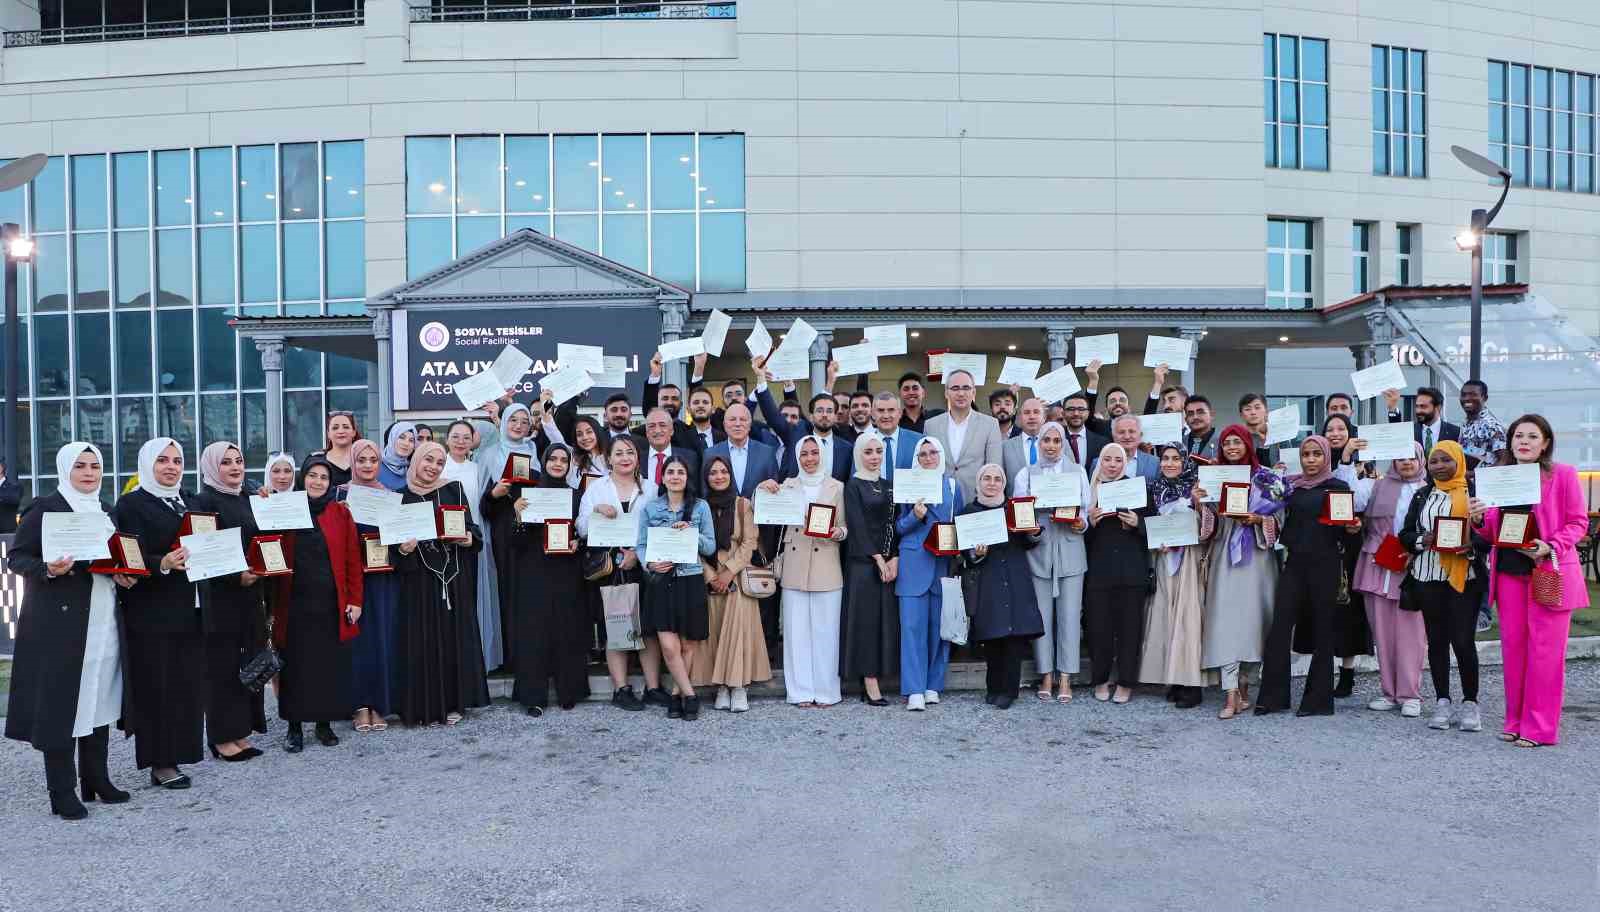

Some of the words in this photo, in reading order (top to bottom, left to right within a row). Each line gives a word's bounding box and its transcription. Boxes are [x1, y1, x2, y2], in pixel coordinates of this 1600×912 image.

[455, 327, 494, 336] SOSYAL
[496, 326, 543, 336] TESİSLER
[455, 337, 480, 346] Social
[483, 337, 519, 345] Facilities
[420, 361, 460, 376] ATA
[421, 380, 453, 395] Ata
